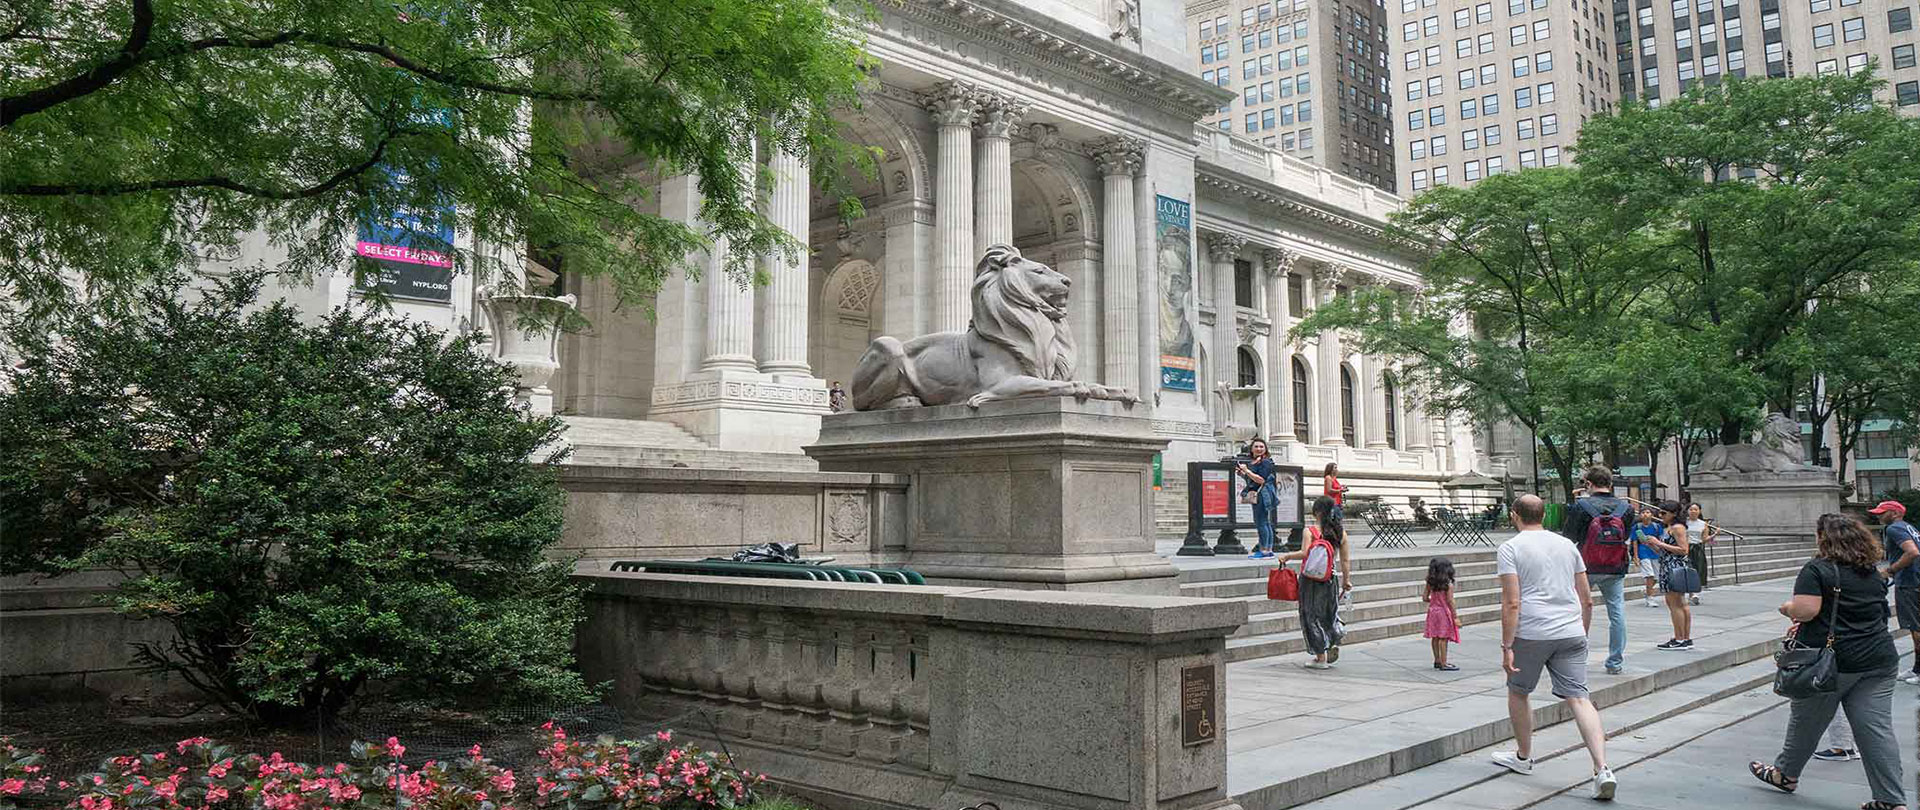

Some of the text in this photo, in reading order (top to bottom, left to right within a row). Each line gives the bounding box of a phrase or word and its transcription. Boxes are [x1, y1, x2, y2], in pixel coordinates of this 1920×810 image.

[901, 20, 969, 58] PUBLIC
[1158, 198, 1188, 218] LOVE
[365, 245, 402, 257] SELECT
[413, 280, 448, 291] NYPL.ORG
